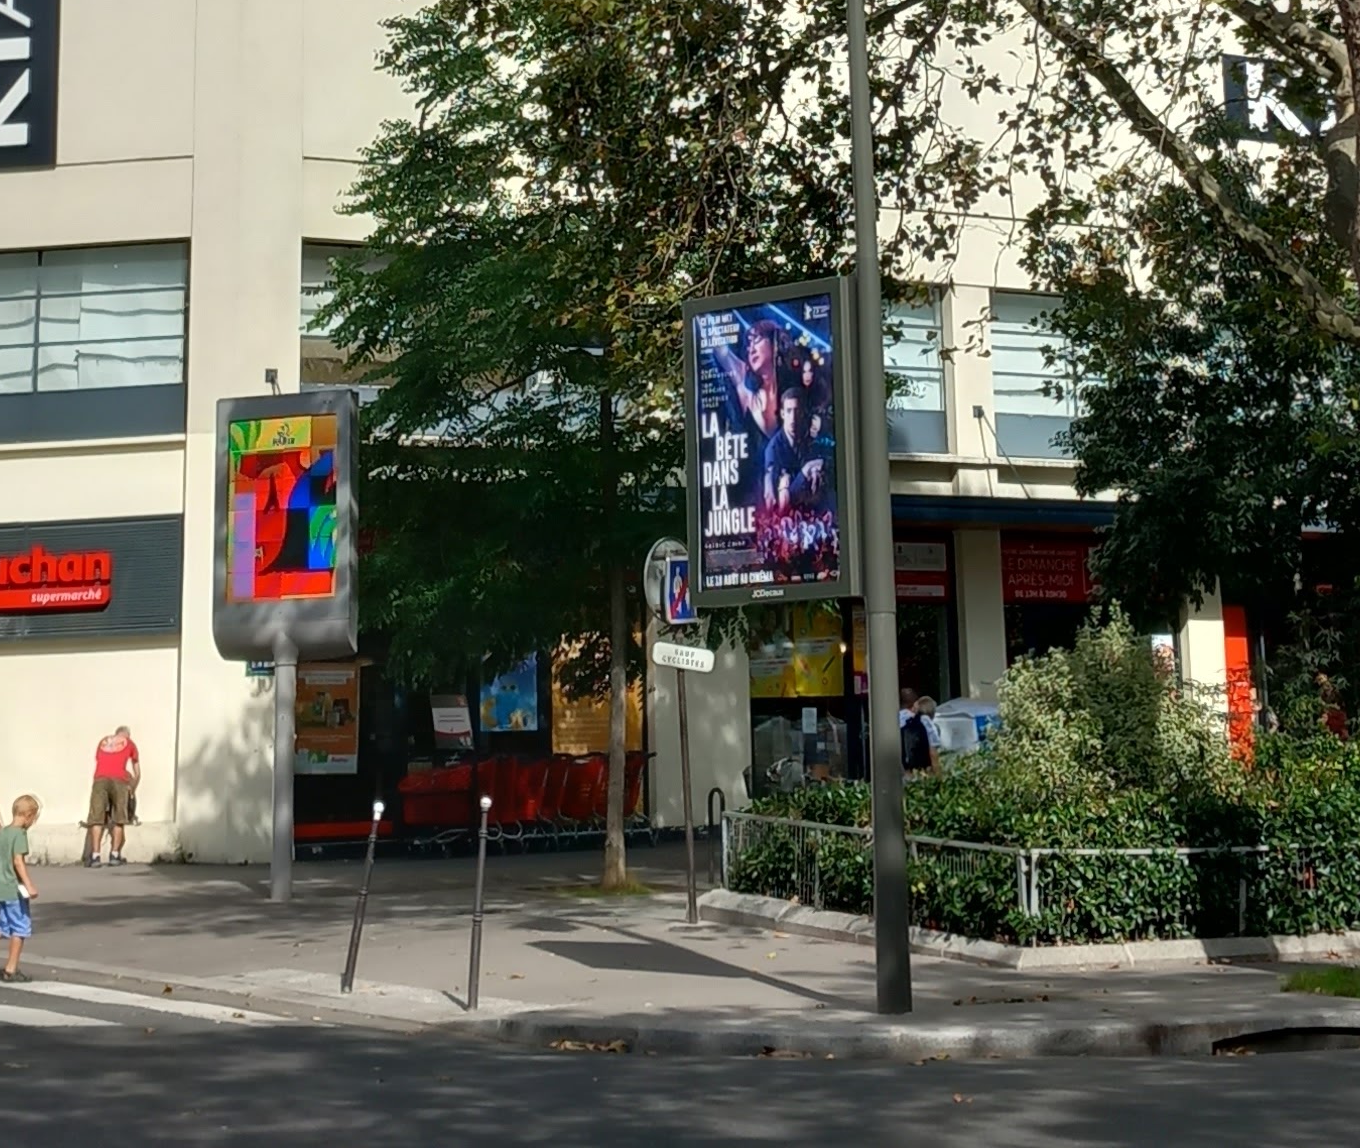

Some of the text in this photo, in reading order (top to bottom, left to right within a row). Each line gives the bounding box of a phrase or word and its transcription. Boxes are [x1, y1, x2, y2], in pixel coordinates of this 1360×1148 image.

[702, 412, 719, 438] LA
[716, 431, 748, 461] BÊTE
[703, 459, 739, 487] DANS
[712, 485, 729, 511] LA
[704, 506, 756, 537] JUNGLE
[1017, 557, 1078, 571] DIMANCHE
[749, 569, 774, 583] CINÉMA
[1008, 571, 1075, 587] APRÈS-MIDI
[31, 587, 103, 605] supermarché
[661, 654, 705, 669] CYCLISTES
